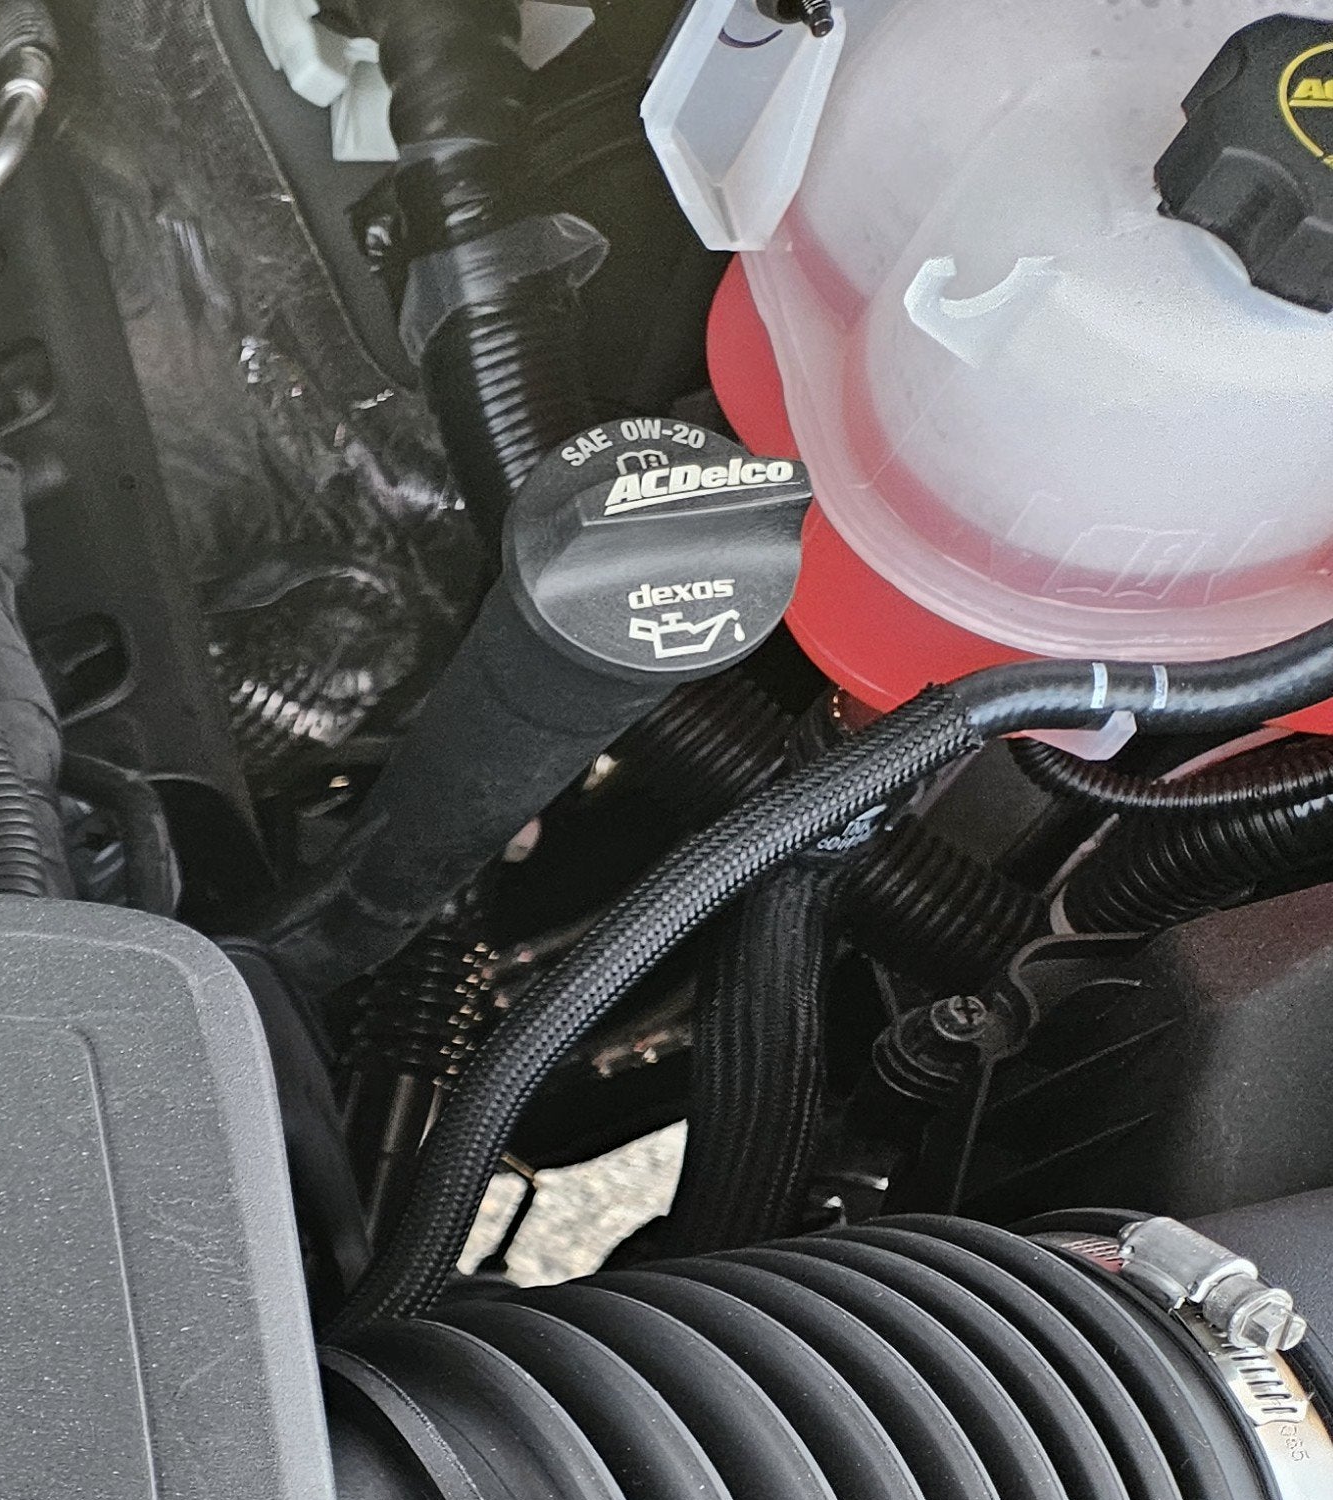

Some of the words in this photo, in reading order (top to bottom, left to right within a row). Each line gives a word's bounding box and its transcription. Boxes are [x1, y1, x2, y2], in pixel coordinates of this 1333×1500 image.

[561, 428, 613, 467] SAE
[620, 419, 706, 449] 0W-20
[604, 457, 794, 507] ACDelco
[628, 579, 736, 610] dexos
